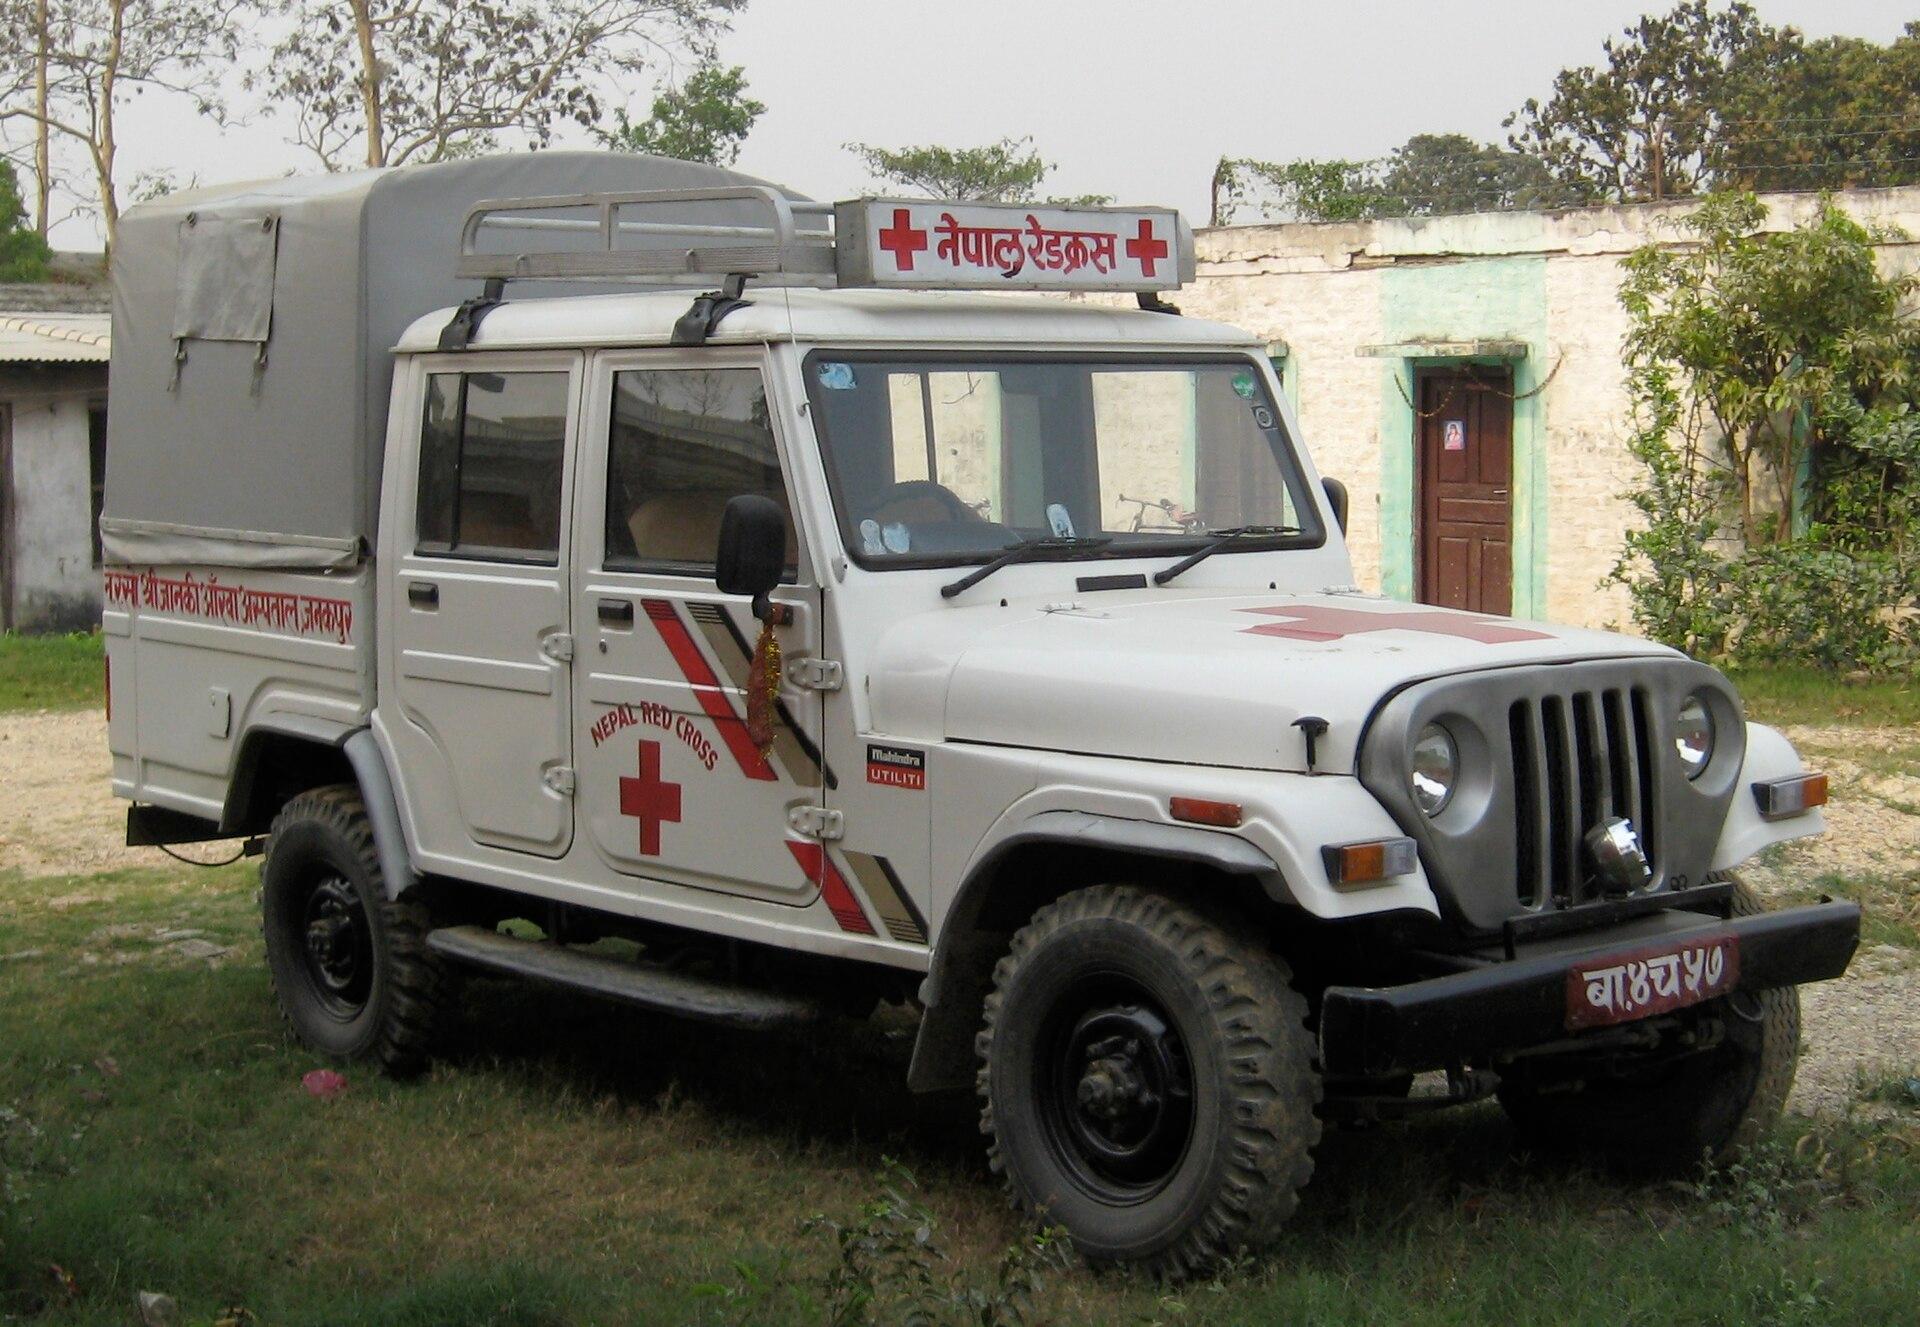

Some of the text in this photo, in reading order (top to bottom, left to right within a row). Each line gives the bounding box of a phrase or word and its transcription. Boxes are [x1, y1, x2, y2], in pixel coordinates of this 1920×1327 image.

[934, 212, 1025, 278] नेपाल
[591, 700, 719, 771] NEPAL RED CROSS
[871, 768, 920, 786] UTILITI
[872, 749, 920, 766] Mahindra
